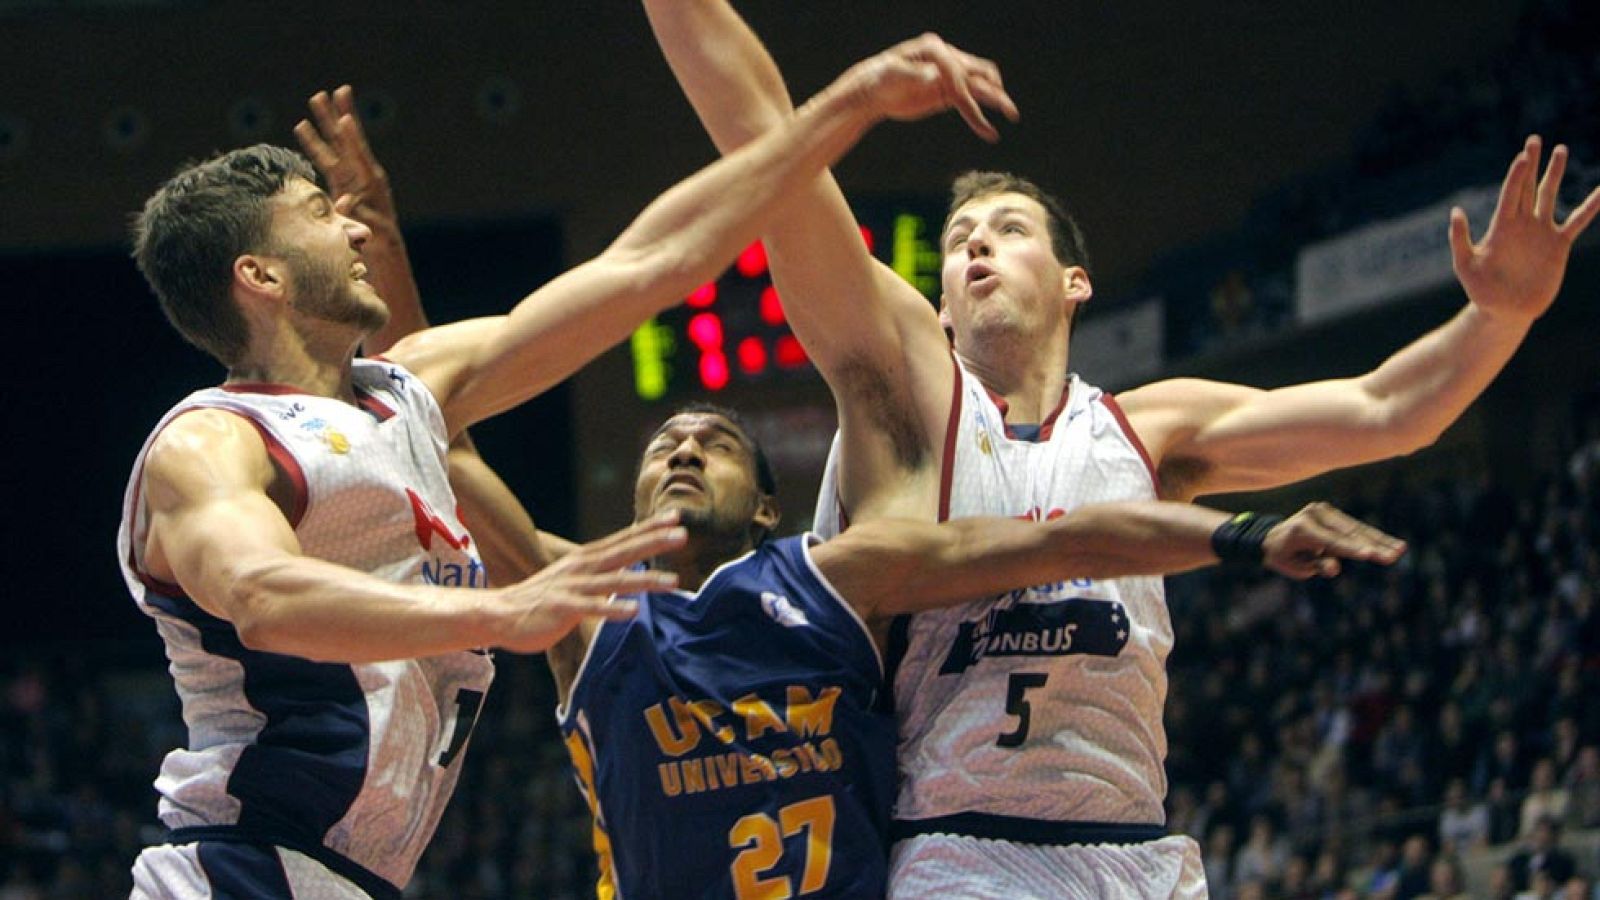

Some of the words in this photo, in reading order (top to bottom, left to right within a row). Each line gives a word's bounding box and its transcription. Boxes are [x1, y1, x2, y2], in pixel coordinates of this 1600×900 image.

[643, 685, 842, 757] UCAM
[996, 672, 1049, 747] 5
[729, 794, 836, 900] 27
